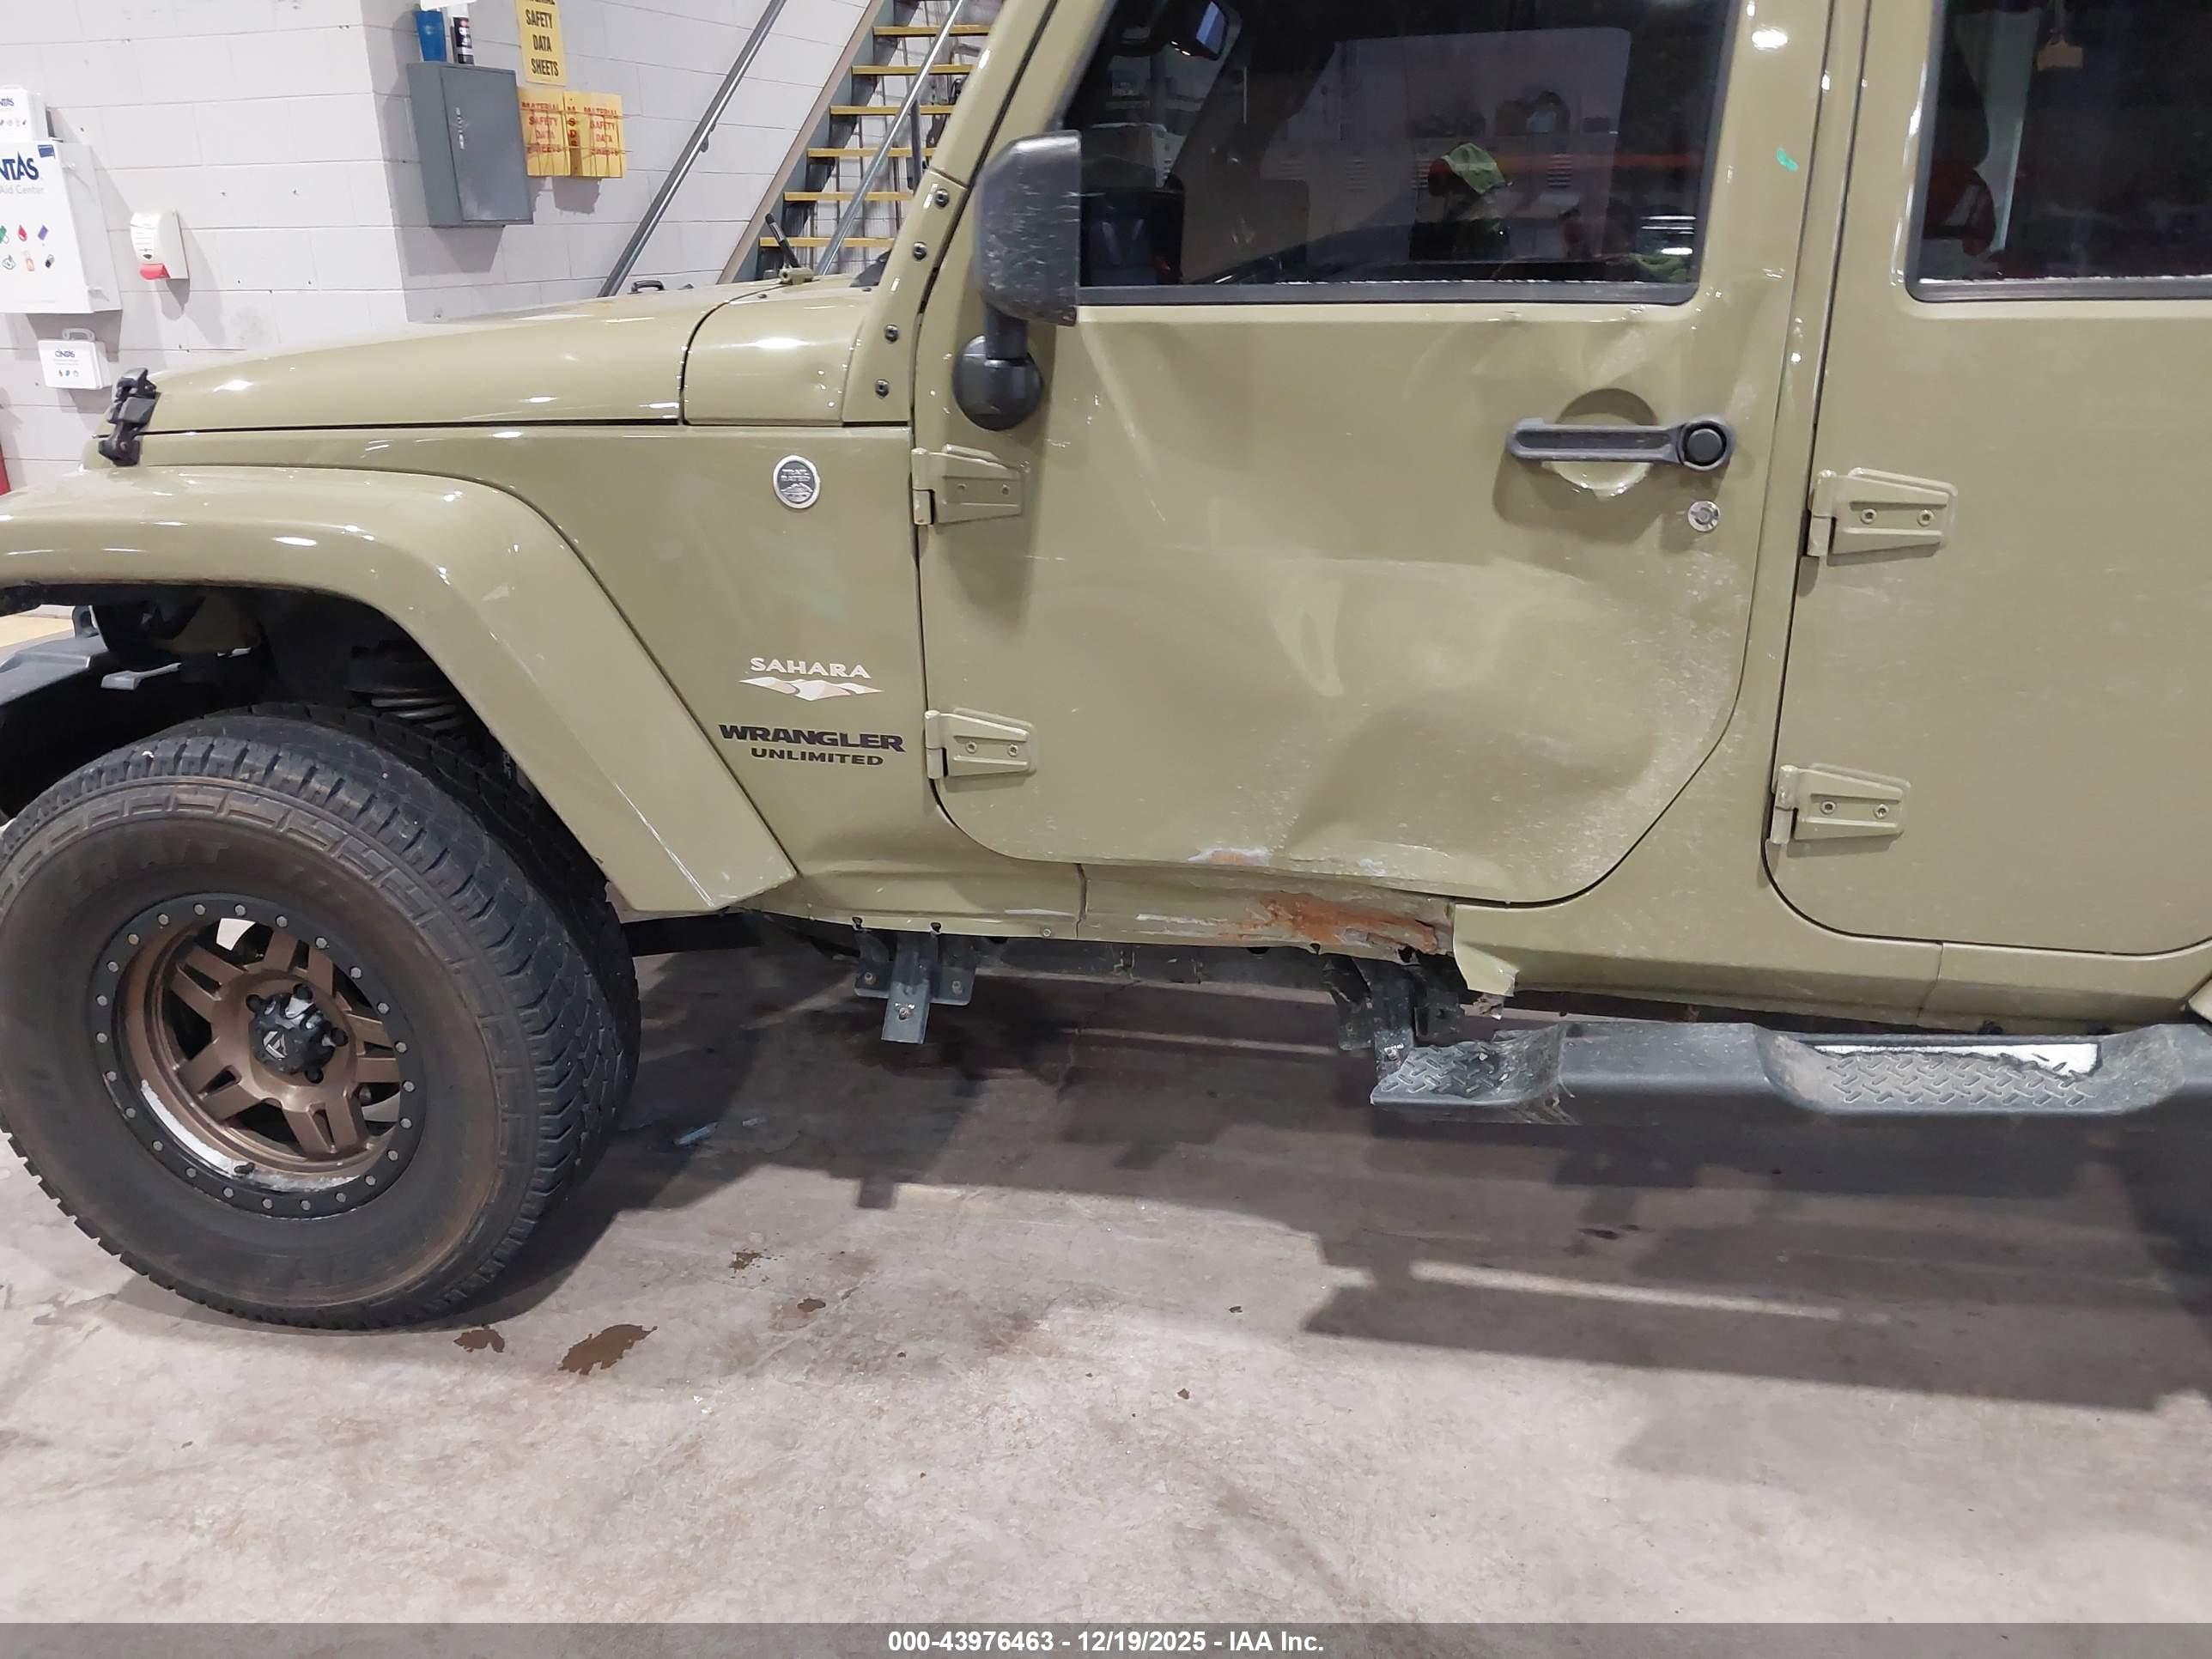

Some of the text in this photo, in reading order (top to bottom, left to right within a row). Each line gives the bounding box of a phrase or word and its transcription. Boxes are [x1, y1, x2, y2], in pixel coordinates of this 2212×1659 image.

[526, 9, 553, 28] SAFETY
[532, 34, 552, 52] DATA
[531, 58, 559, 76] SHEETS
[750, 657, 872, 679] SAHARA
[718, 724, 907, 752] WRANGLER
[750, 747, 884, 766] UNLIMITED
